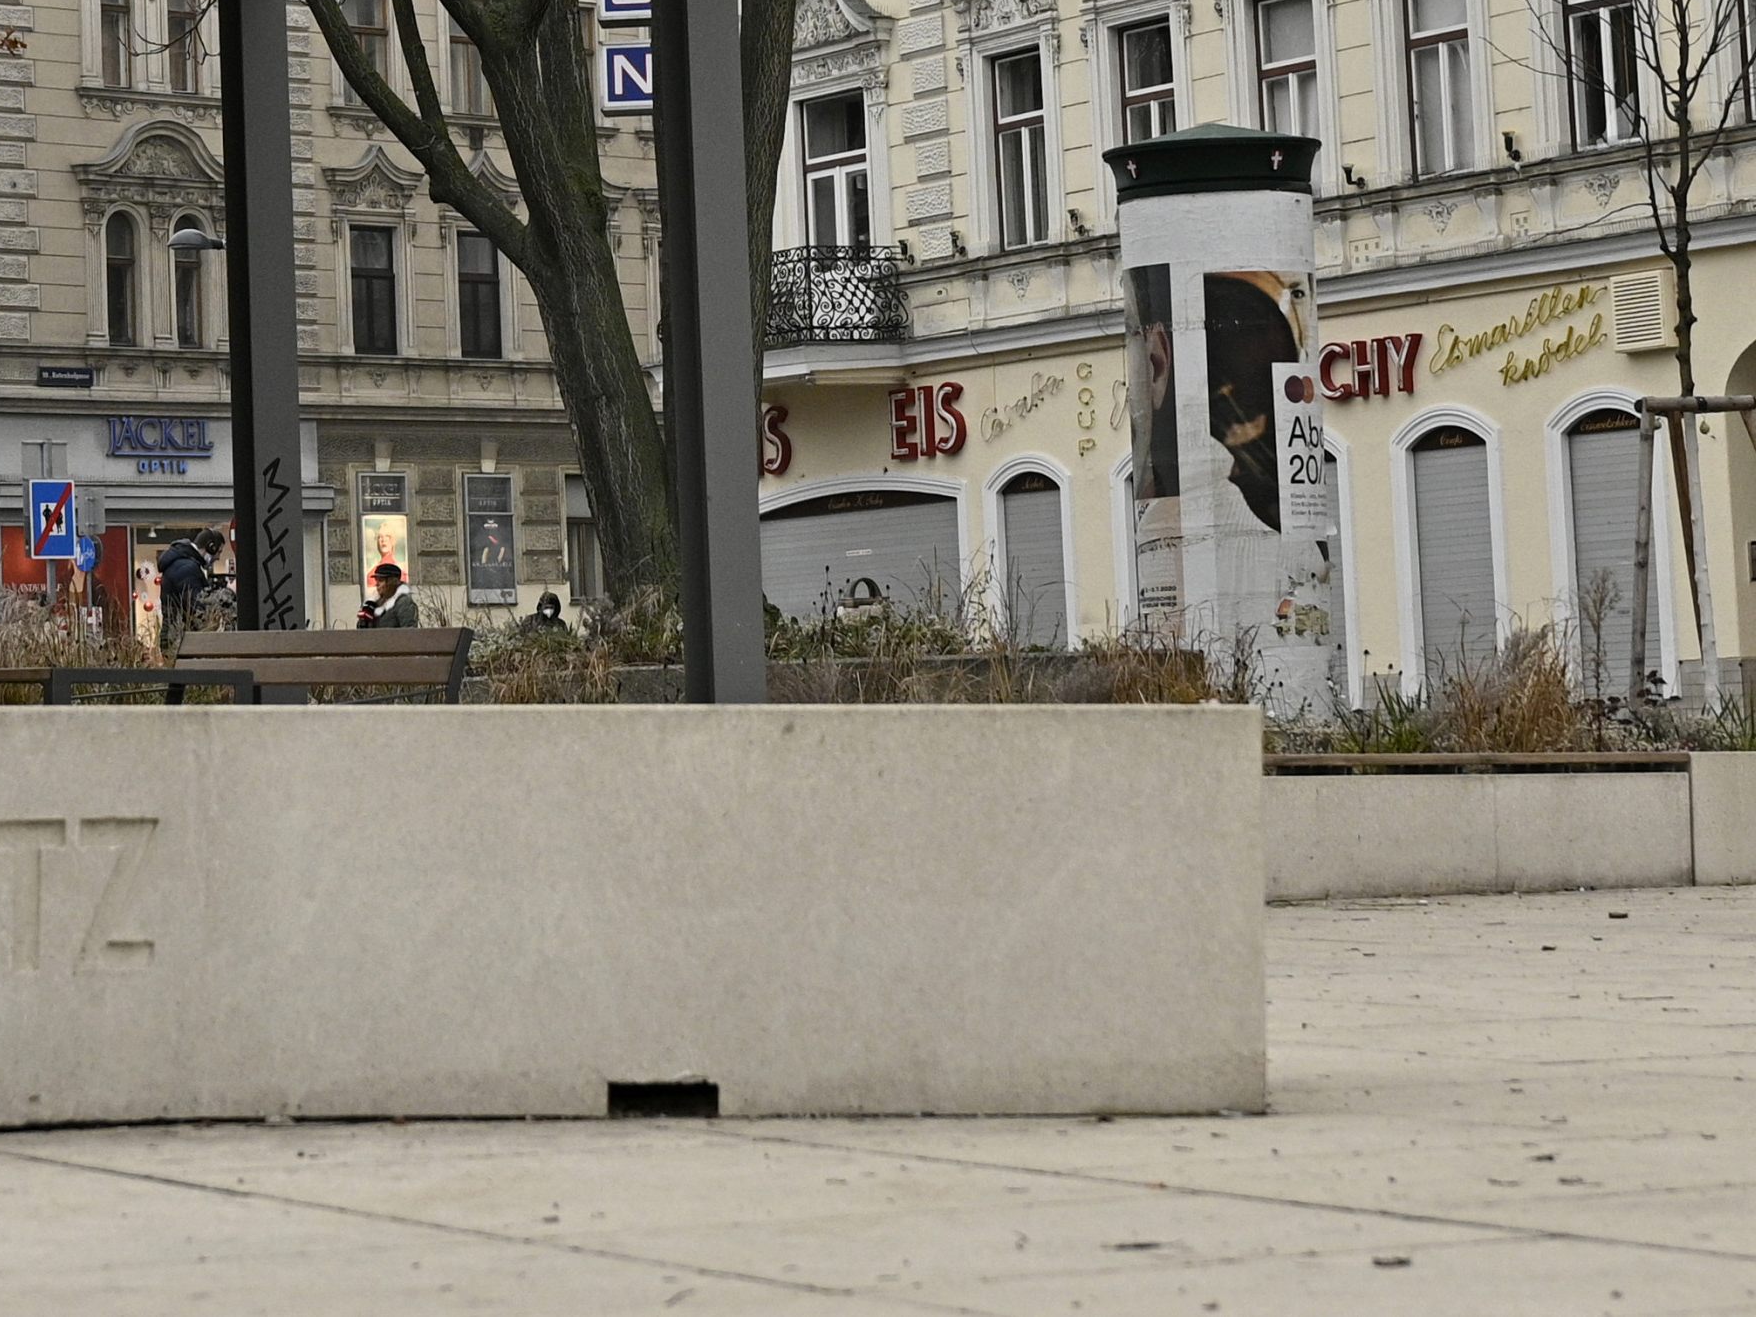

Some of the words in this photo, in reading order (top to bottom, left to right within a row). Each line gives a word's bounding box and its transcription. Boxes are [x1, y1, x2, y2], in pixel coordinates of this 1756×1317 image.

[1319, 333, 1423, 401] CHY
[106, 416, 214, 457] JÄCKEL
[889, 382, 967, 460] EIS
[137, 459, 189, 475] OPTIK
